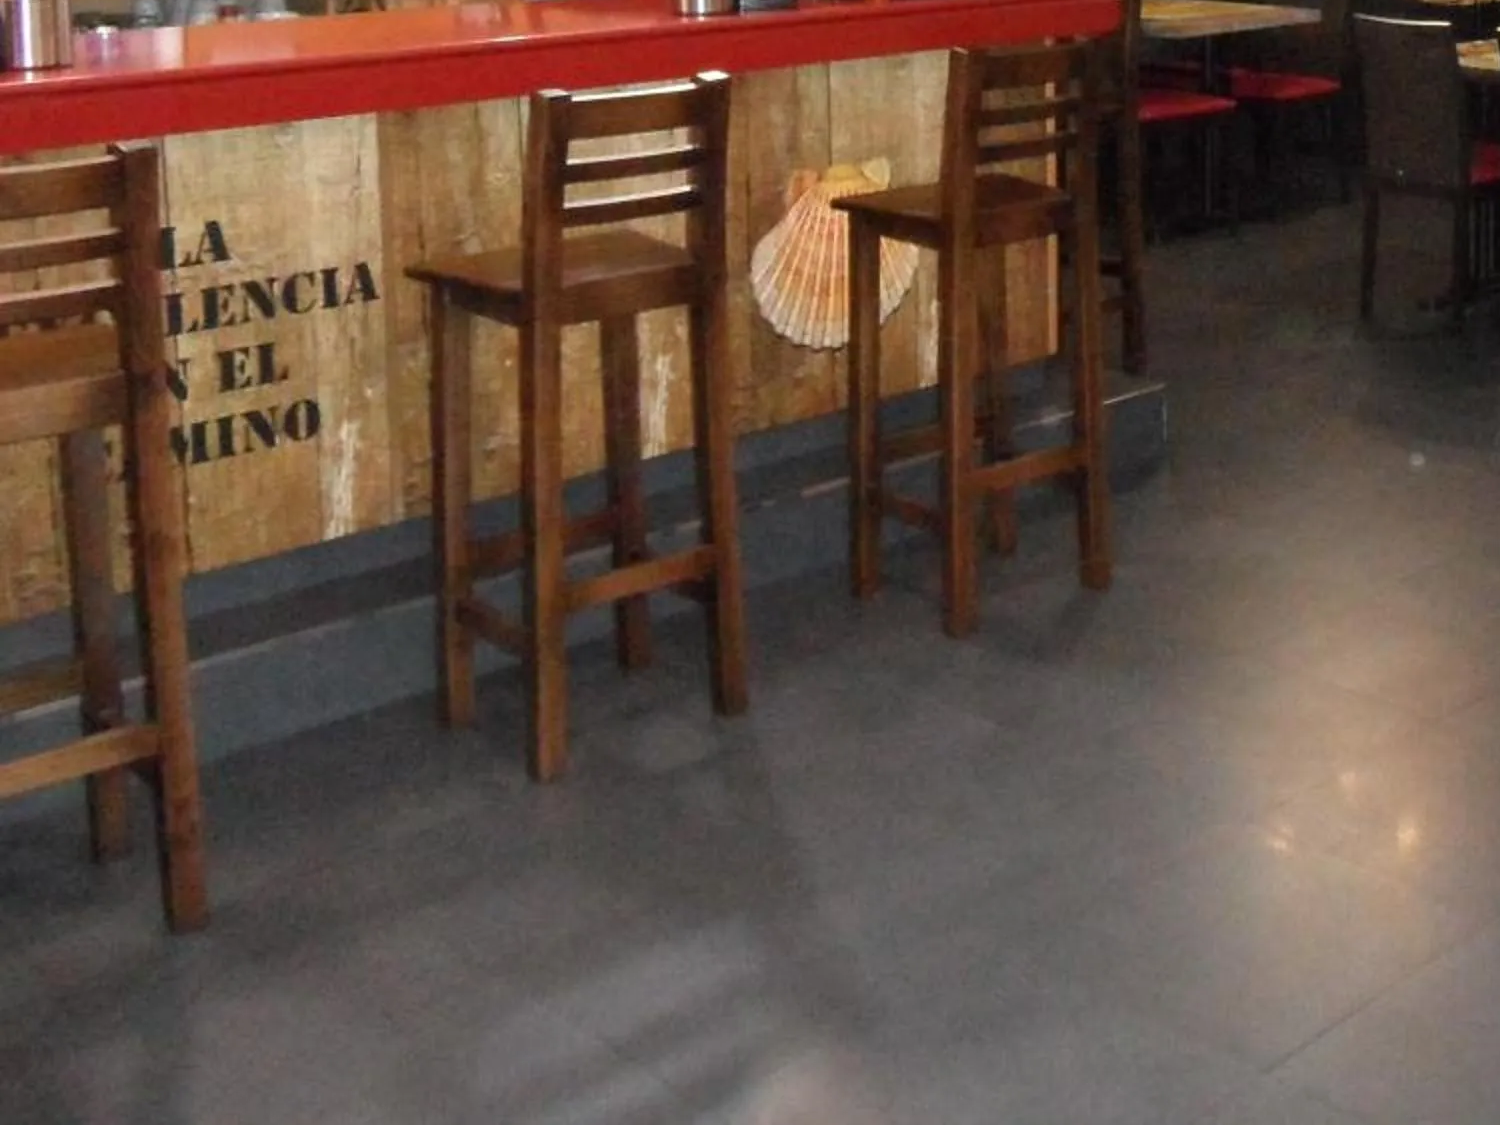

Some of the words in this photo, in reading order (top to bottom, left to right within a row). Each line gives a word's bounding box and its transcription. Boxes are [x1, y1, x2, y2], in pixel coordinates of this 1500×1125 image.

[161, 220, 232, 270] LA
[163, 261, 380, 336] LENCIA
[217, 342, 290, 394] EL
[170, 398, 322, 466] MINO
